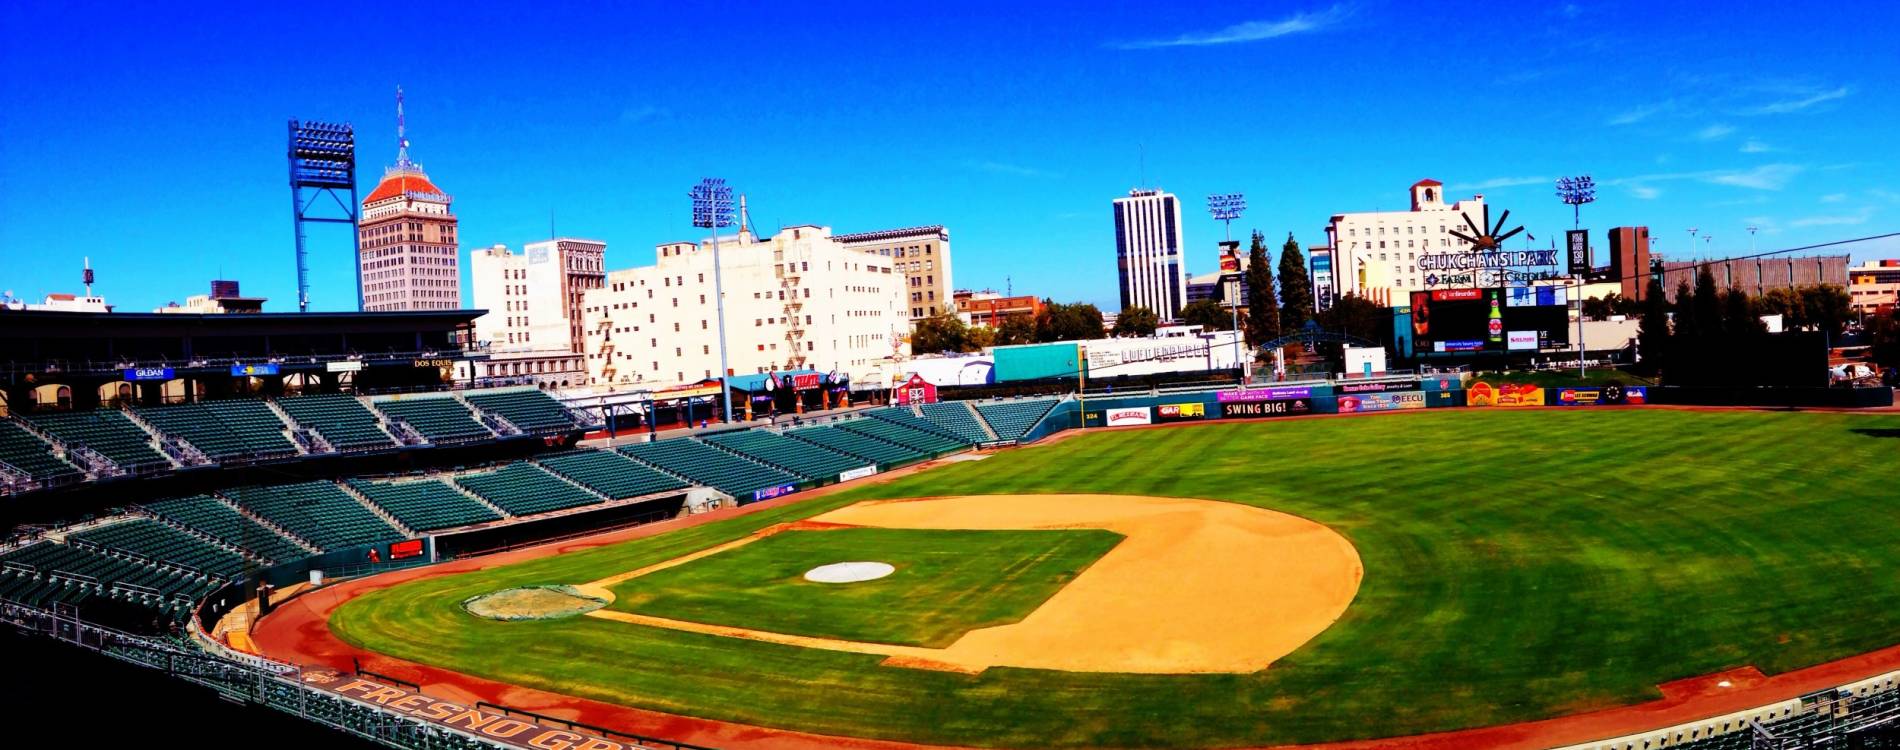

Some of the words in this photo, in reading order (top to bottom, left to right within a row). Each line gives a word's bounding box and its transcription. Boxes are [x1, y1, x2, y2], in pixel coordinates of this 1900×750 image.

[1417, 252, 1514, 270] CHUKCHANSI
[1518, 250, 1559, 266] PARK
[1441, 274, 1472, 284] FARM
[136, 369, 164, 377] GILDAN
[1401, 394, 1423, 402] EECU
[1161, 405, 1179, 414] GAR
[1226, 404, 1261, 415] SWING
[1264, 402, 1287, 413] BIG!
[335, 679, 538, 737] FRESNO
